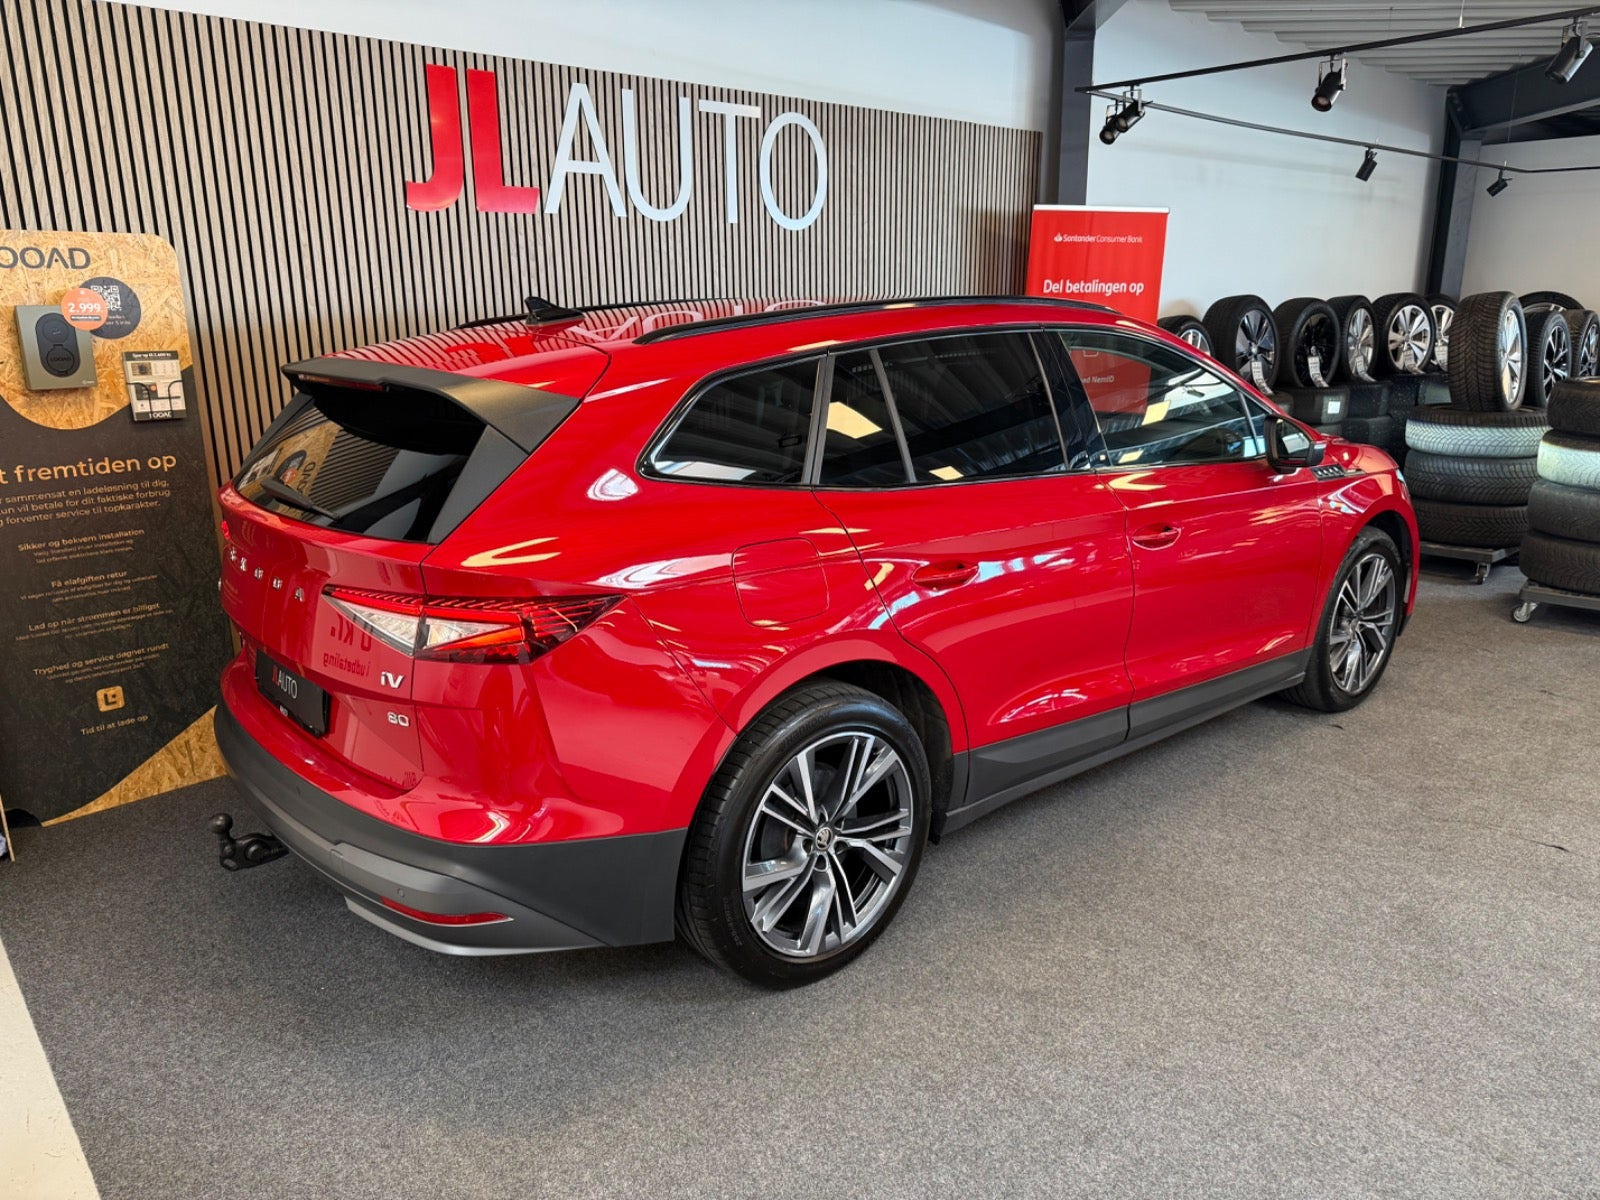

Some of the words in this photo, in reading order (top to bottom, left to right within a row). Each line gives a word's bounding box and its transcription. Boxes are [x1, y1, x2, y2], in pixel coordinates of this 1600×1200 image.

[1128, 235, 1142, 243] Bank
[1043, 280, 1063, 293] Del
[1066, 279, 1127, 297] betalingen
[1129, 283, 1144, 295] op
[68, 303, 101, 313] 2.999
[14, 458, 141, 483] fremtiden
[147, 455, 177, 472] op
[5, 490, 66, 504] sammensat
[68, 489, 81, 497] en
[140, 480, 150, 489] til
[18, 504, 29, 512] vil
[32, 500, 64, 511] betale
[81, 497, 96, 505] dit
[97, 492, 135, 504] faktiske
[135, 489, 171, 499] forbrug
[6, 512, 53, 525] forventer
[55, 508, 91, 519] service
[92, 505, 102, 514] til
[17, 542, 46, 552] Sikker
[48, 540, 60, 548] og
[62, 535, 97, 546] bekvem
[98, 529, 145, 541] installation
[106, 570, 128, 579] retur
[28, 622, 46, 631] Lad
[47, 621, 59, 629] op
[33, 663, 70, 676] Tryghed
[72, 660, 84, 668] og
[85, 654, 114, 665] service
[381, 671, 404, 689] iV
[81, 726, 95, 735] Tid
[96, 724, 105, 732] til
[107, 721, 115, 729] at
[137, 715, 149, 723] op
